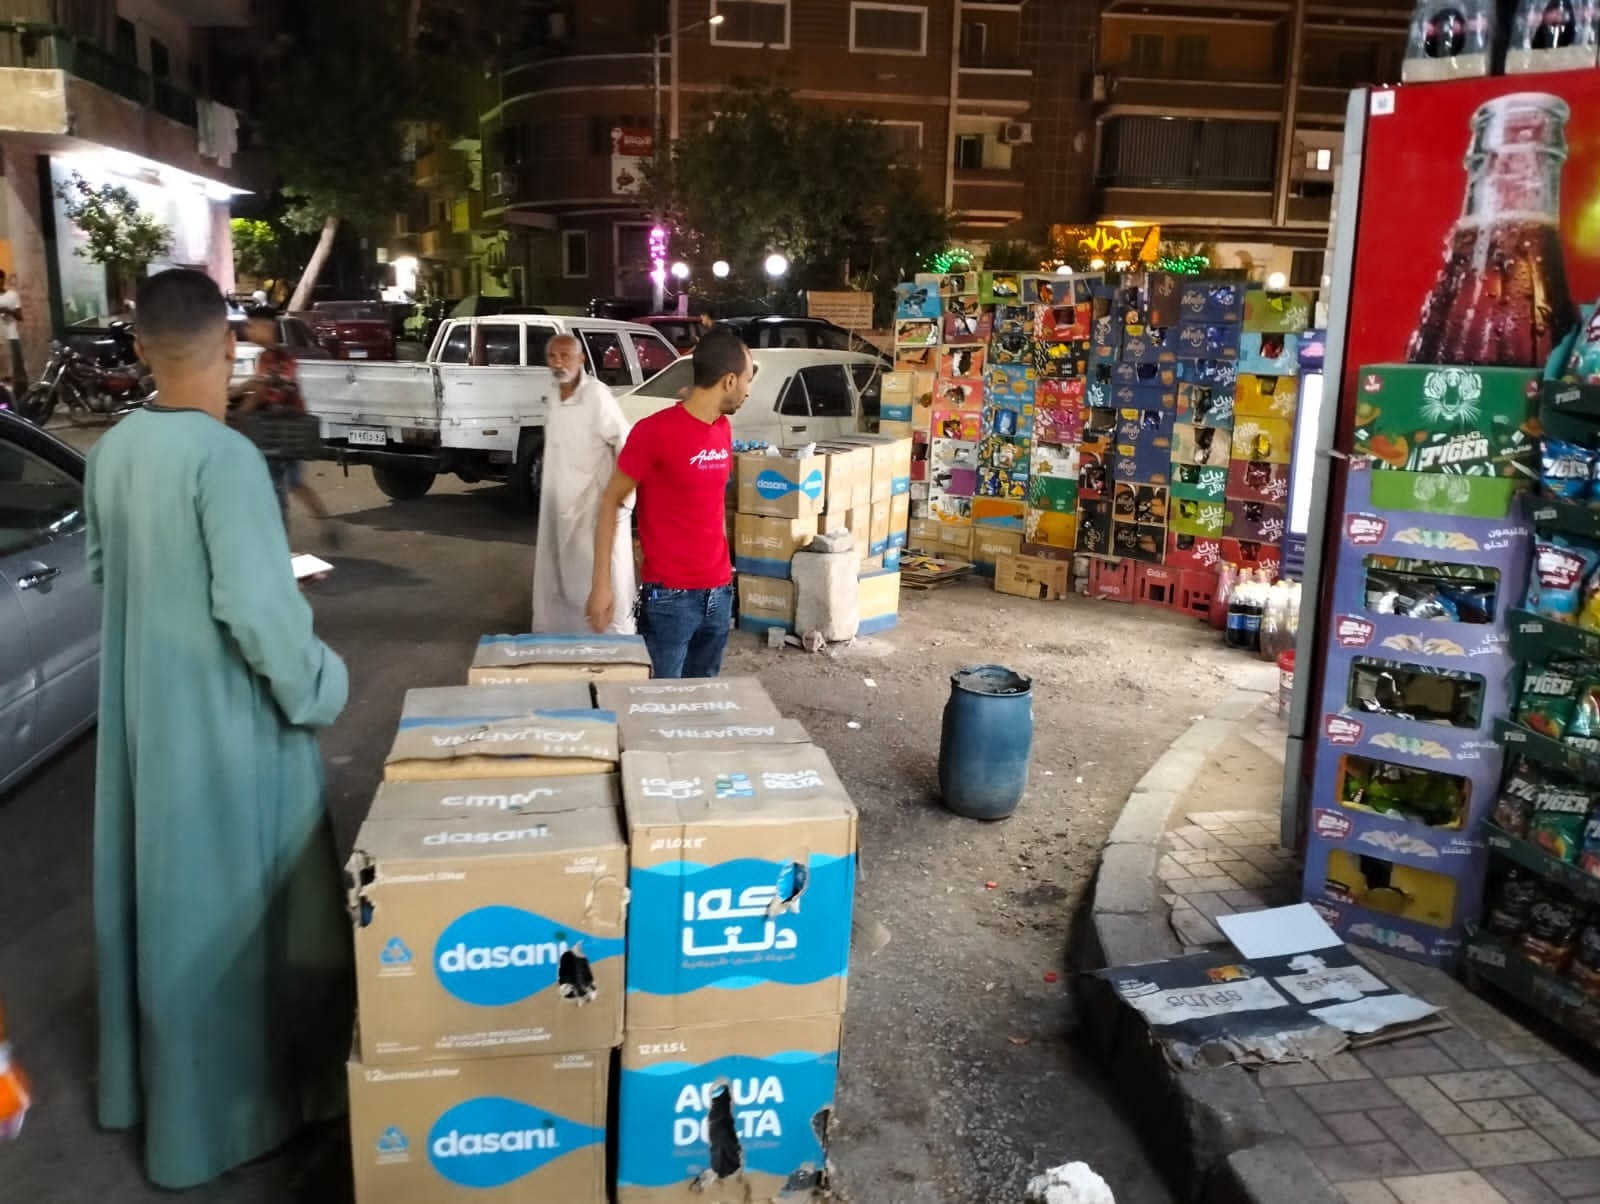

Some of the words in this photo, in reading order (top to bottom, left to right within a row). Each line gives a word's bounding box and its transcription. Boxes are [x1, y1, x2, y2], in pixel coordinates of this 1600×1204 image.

[1419, 439, 1489, 468] TIGER
[628, 700, 740, 715] AQUAFINA
[432, 728, 586, 747] AQUAFINA
[1536, 792, 1590, 814] TIGER
[423, 823, 550, 847] dasani
[682, 920, 798, 957] دلتا
[433, 1118, 559, 1157] dasani
[673, 1109, 782, 1146] DTA
